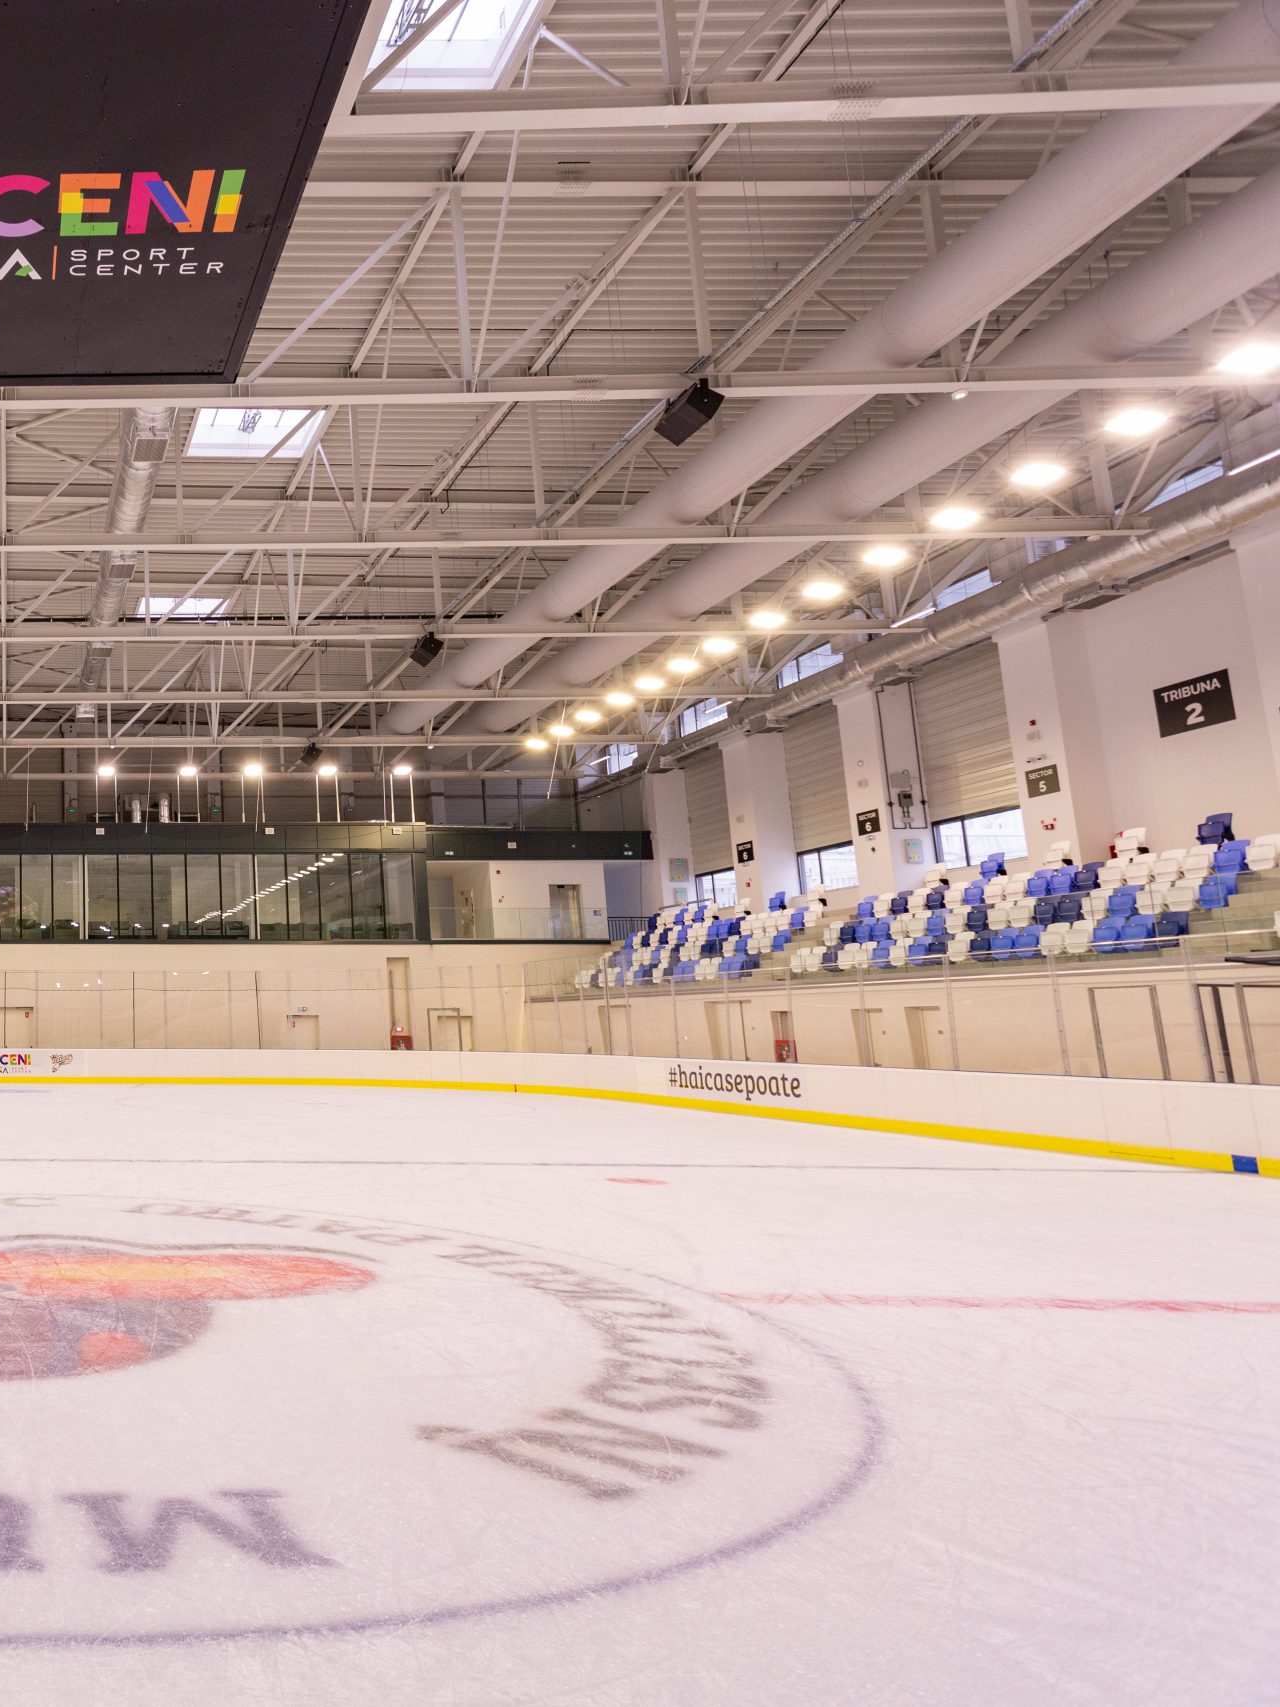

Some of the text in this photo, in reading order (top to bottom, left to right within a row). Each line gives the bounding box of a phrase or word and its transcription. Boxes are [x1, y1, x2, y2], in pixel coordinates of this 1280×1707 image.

[70, 246, 196, 262] SPORT
[69, 261, 224, 277] CENTER
[1160, 678, 1222, 704] TRIBUNA
[1184, 702, 1206, 726] 2
[1028, 768, 1054, 780] SECTOR
[1038, 780, 1047, 793] 5
[865, 821, 872, 832] 6
[742, 851, 749, 861] 6
[669, 1063, 802, 1101] #haicasepoate
